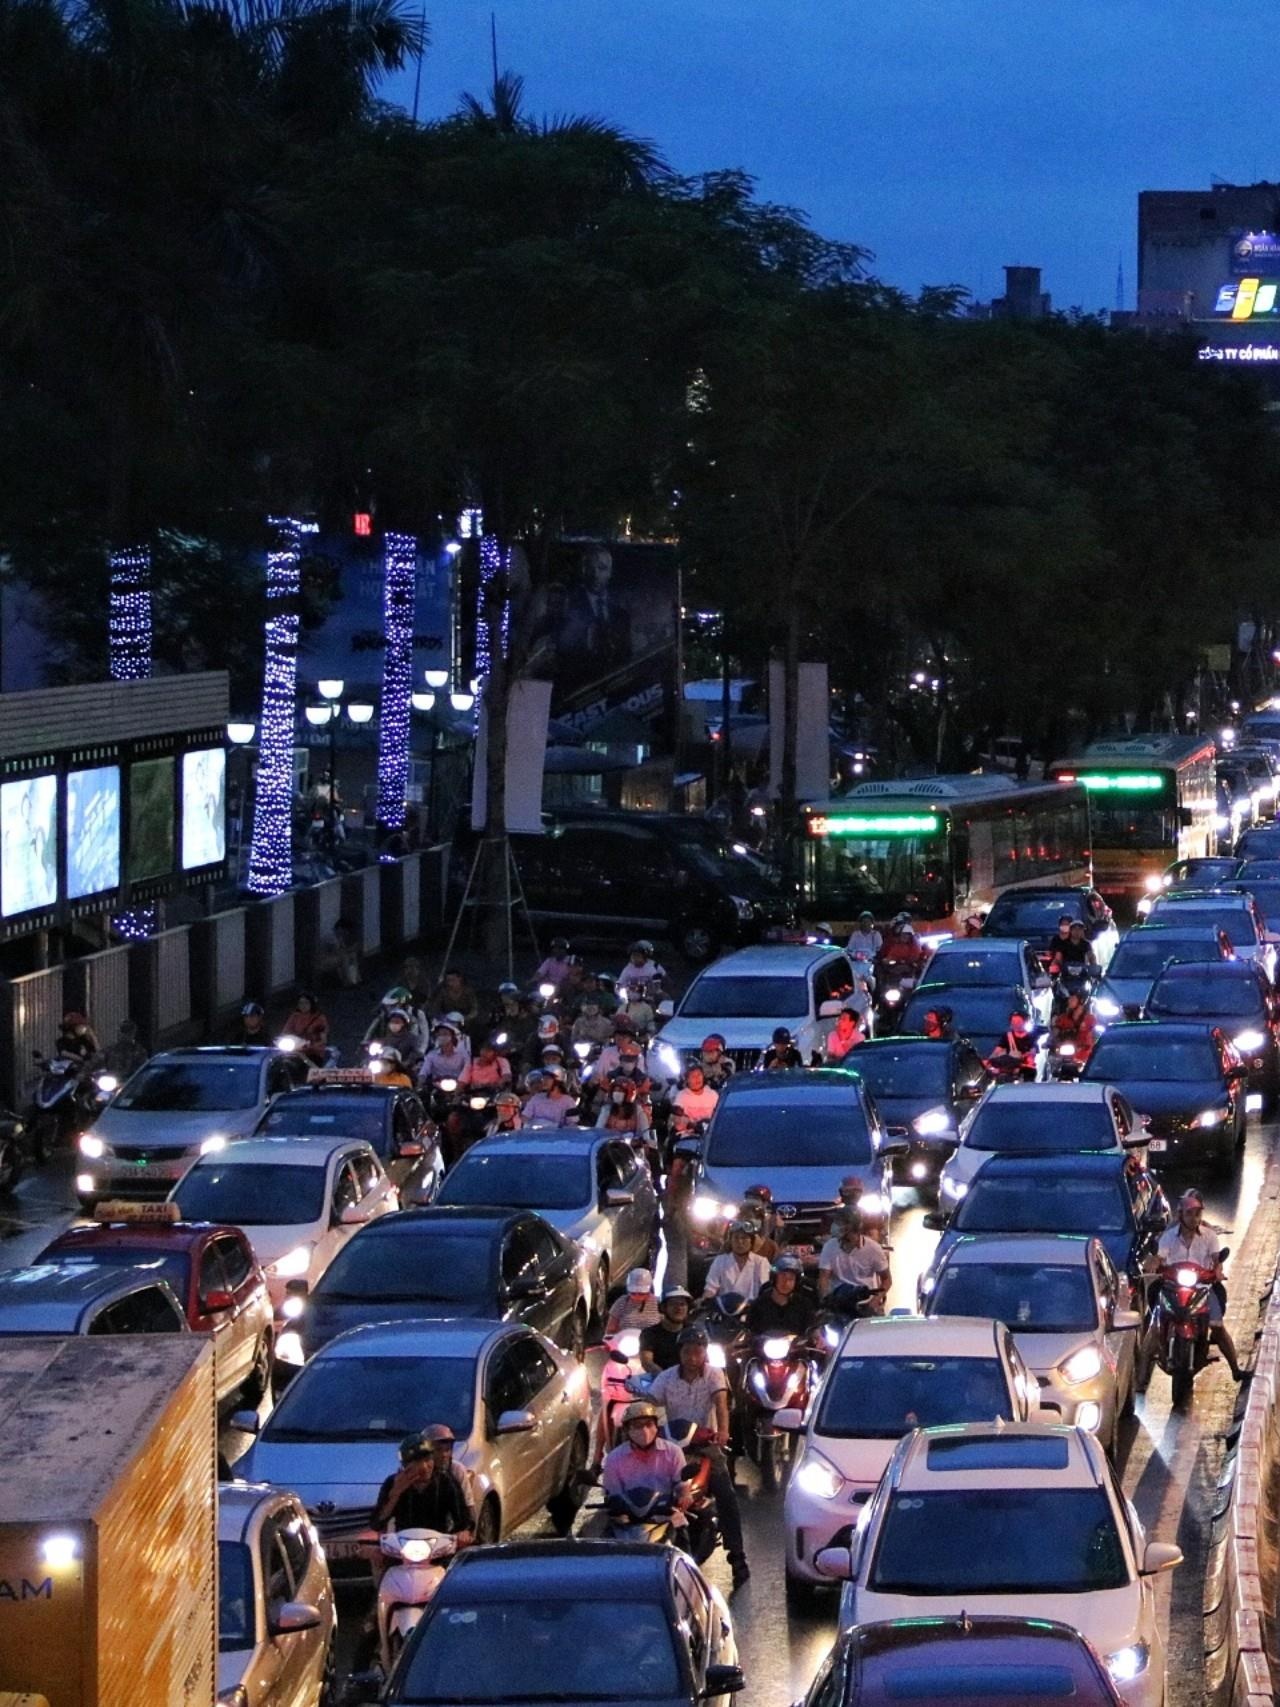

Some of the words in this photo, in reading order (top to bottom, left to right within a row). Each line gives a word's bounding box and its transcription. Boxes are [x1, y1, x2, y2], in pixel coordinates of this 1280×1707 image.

[1225, 349, 1238, 359] TY
[1150, 1141, 1161, 1151] 68
[141, 1204, 168, 1214] TAXI
